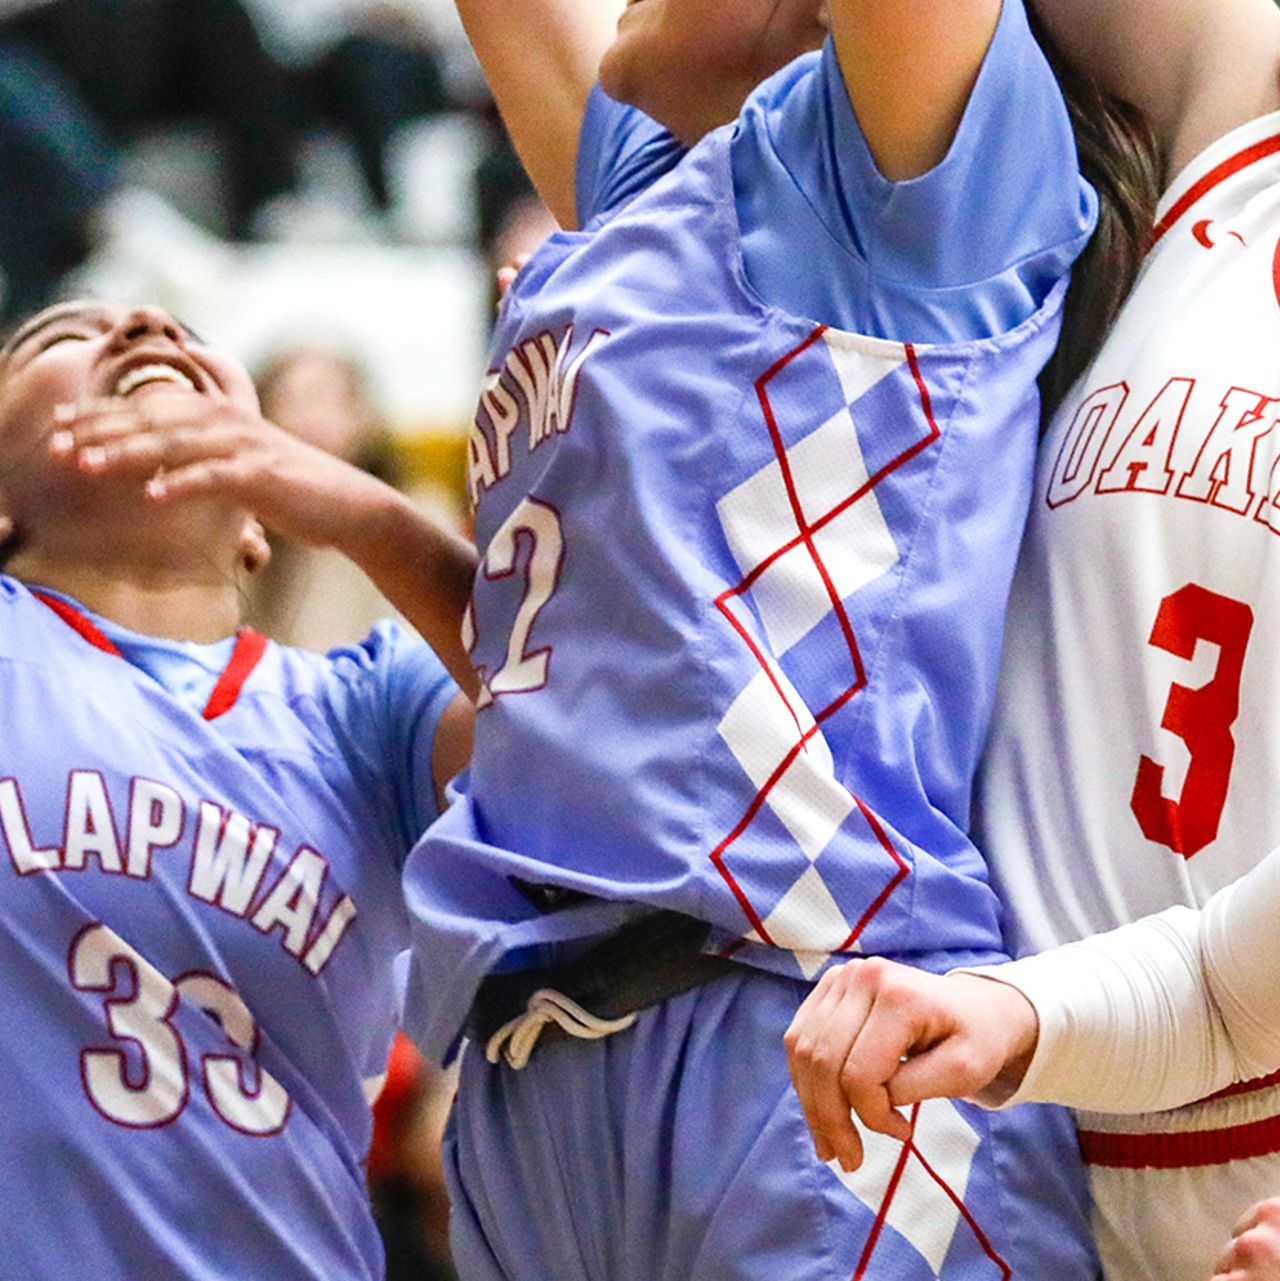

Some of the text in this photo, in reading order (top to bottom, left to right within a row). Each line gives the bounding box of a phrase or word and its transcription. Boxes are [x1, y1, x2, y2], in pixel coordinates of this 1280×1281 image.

[467, 323, 612, 517] APWAI
[461, 495, 568, 711] 2
[1129, 582, 1255, 862] 3
[67, 920, 294, 1159] 33
